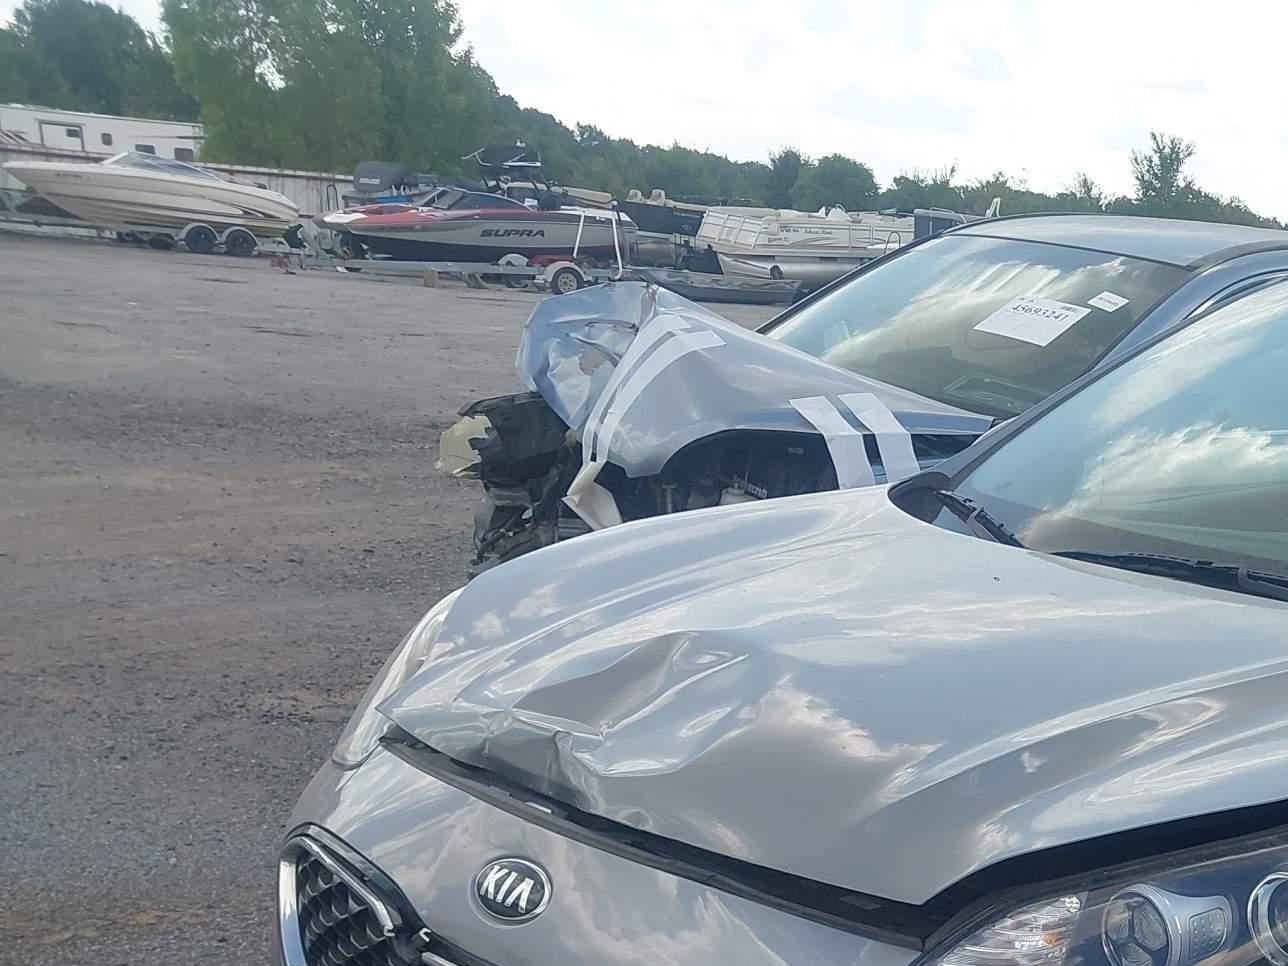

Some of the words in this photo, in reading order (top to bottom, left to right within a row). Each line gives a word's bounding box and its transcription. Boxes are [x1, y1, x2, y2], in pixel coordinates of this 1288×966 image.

[479, 229, 545, 238] SUPRA
[1011, 304, 1070, 321] 45693241
[480, 864, 535, 914] KIA
